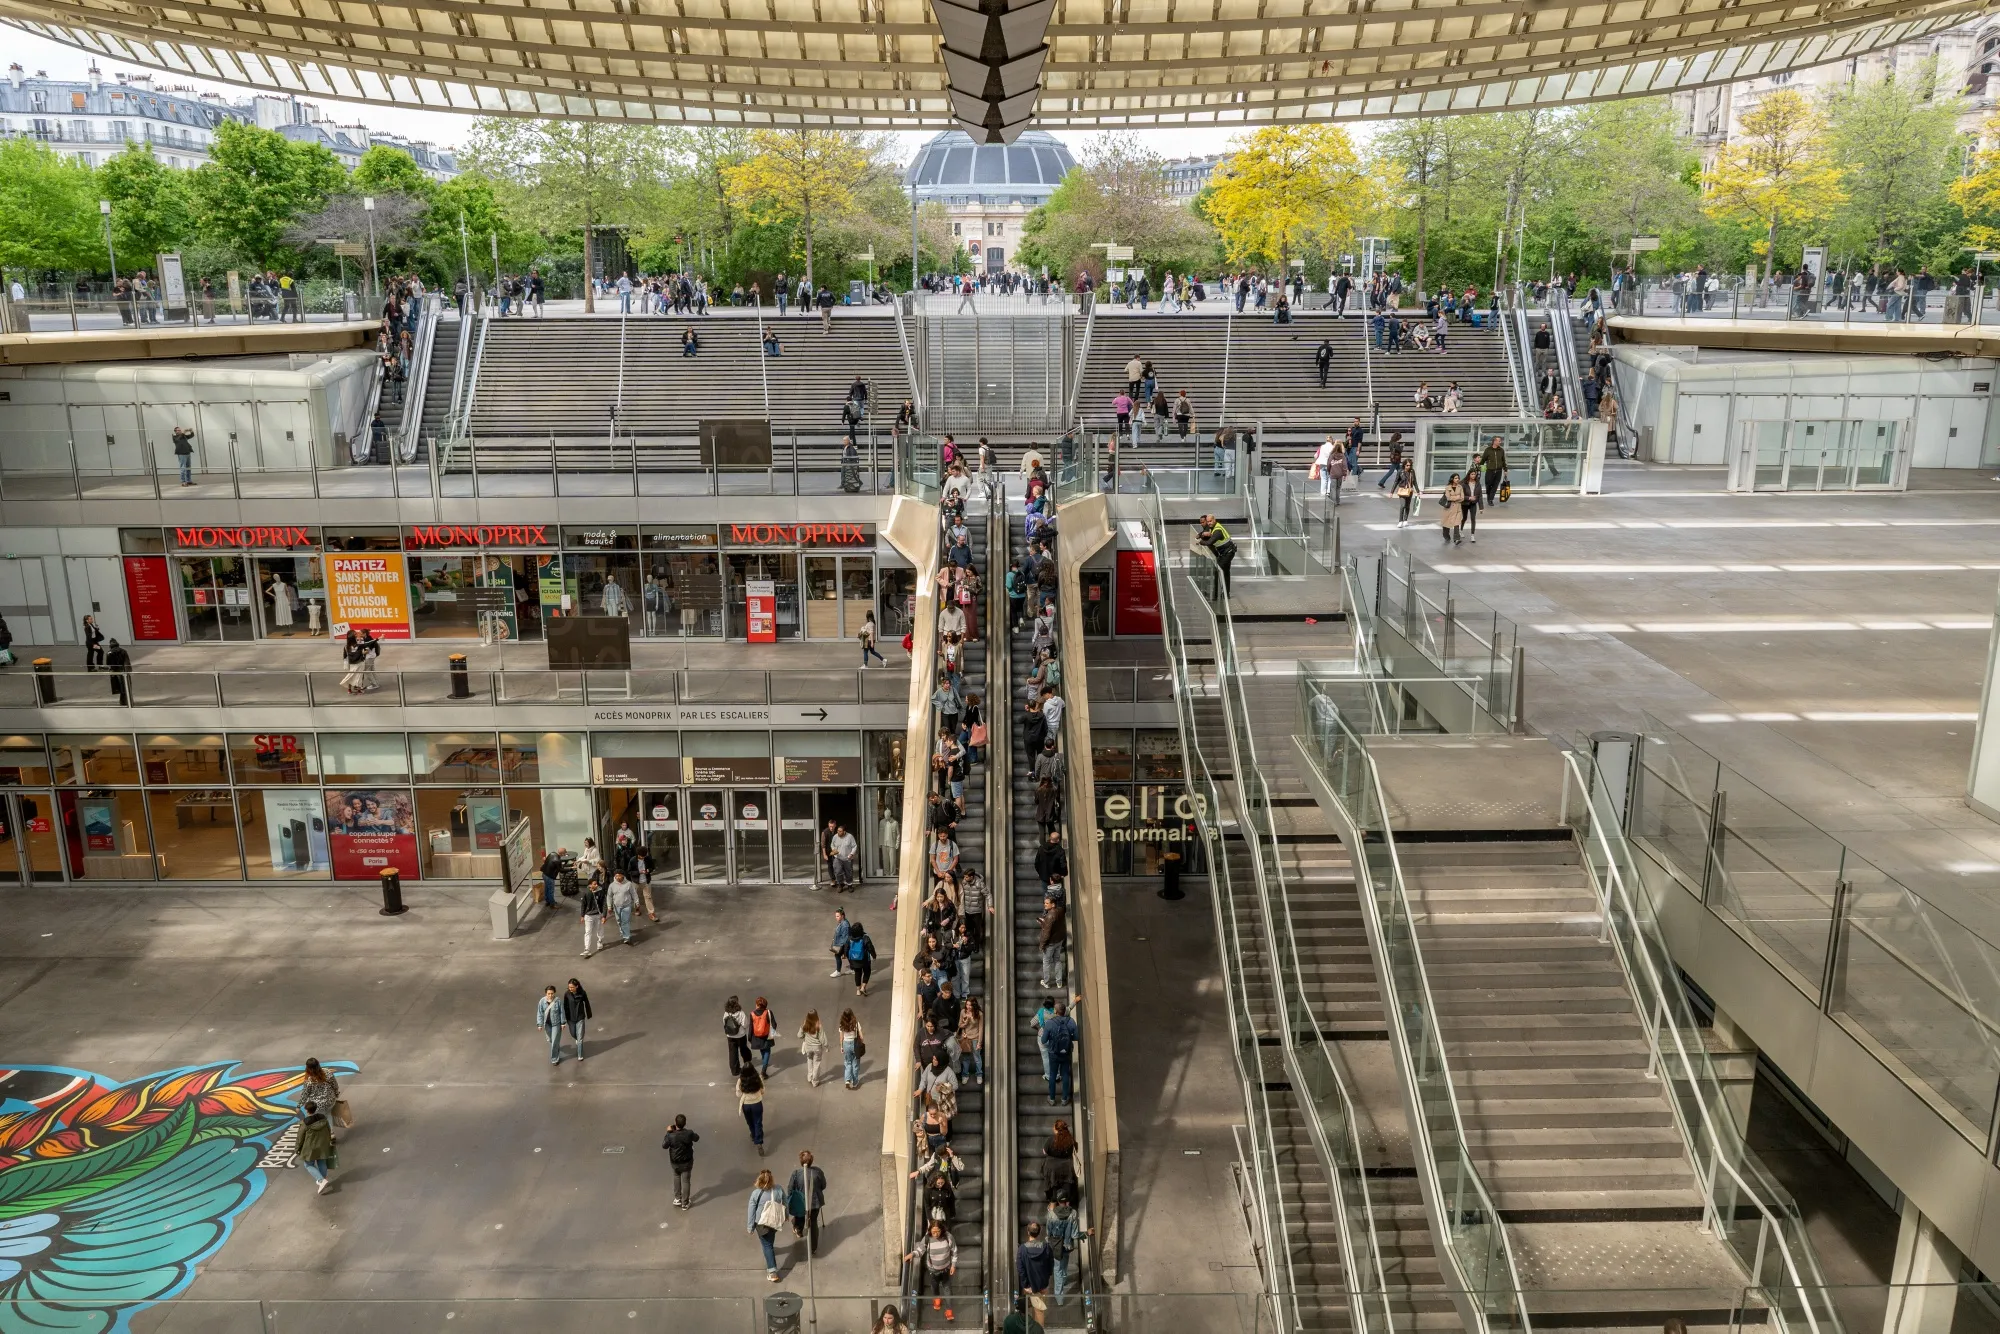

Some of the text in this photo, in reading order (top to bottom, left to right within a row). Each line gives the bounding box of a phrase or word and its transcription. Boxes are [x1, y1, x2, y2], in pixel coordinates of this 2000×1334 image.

[175, 526, 311, 547] MONOPRIX
[412, 525, 548, 545] MONOPRIX
[583, 530, 606, 538] mode
[653, 532, 707, 541] alimentation
[731, 523, 865, 543] MONOPRIX
[584, 537, 614, 545] beauté
[334, 560, 386, 571] PARTEZ
[335, 572, 399, 582] SANS PORTER
[337, 584, 375, 594] AVEC LA
[337, 596, 388, 606] LIVRAISON
[340, 606, 347, 618] À
[347, 608, 393, 618] DOMICILE
[594, 710, 769, 720] ACCÈS MONOPRIX PAR LES ESCALIERS
[254, 734, 297, 753] SFR
